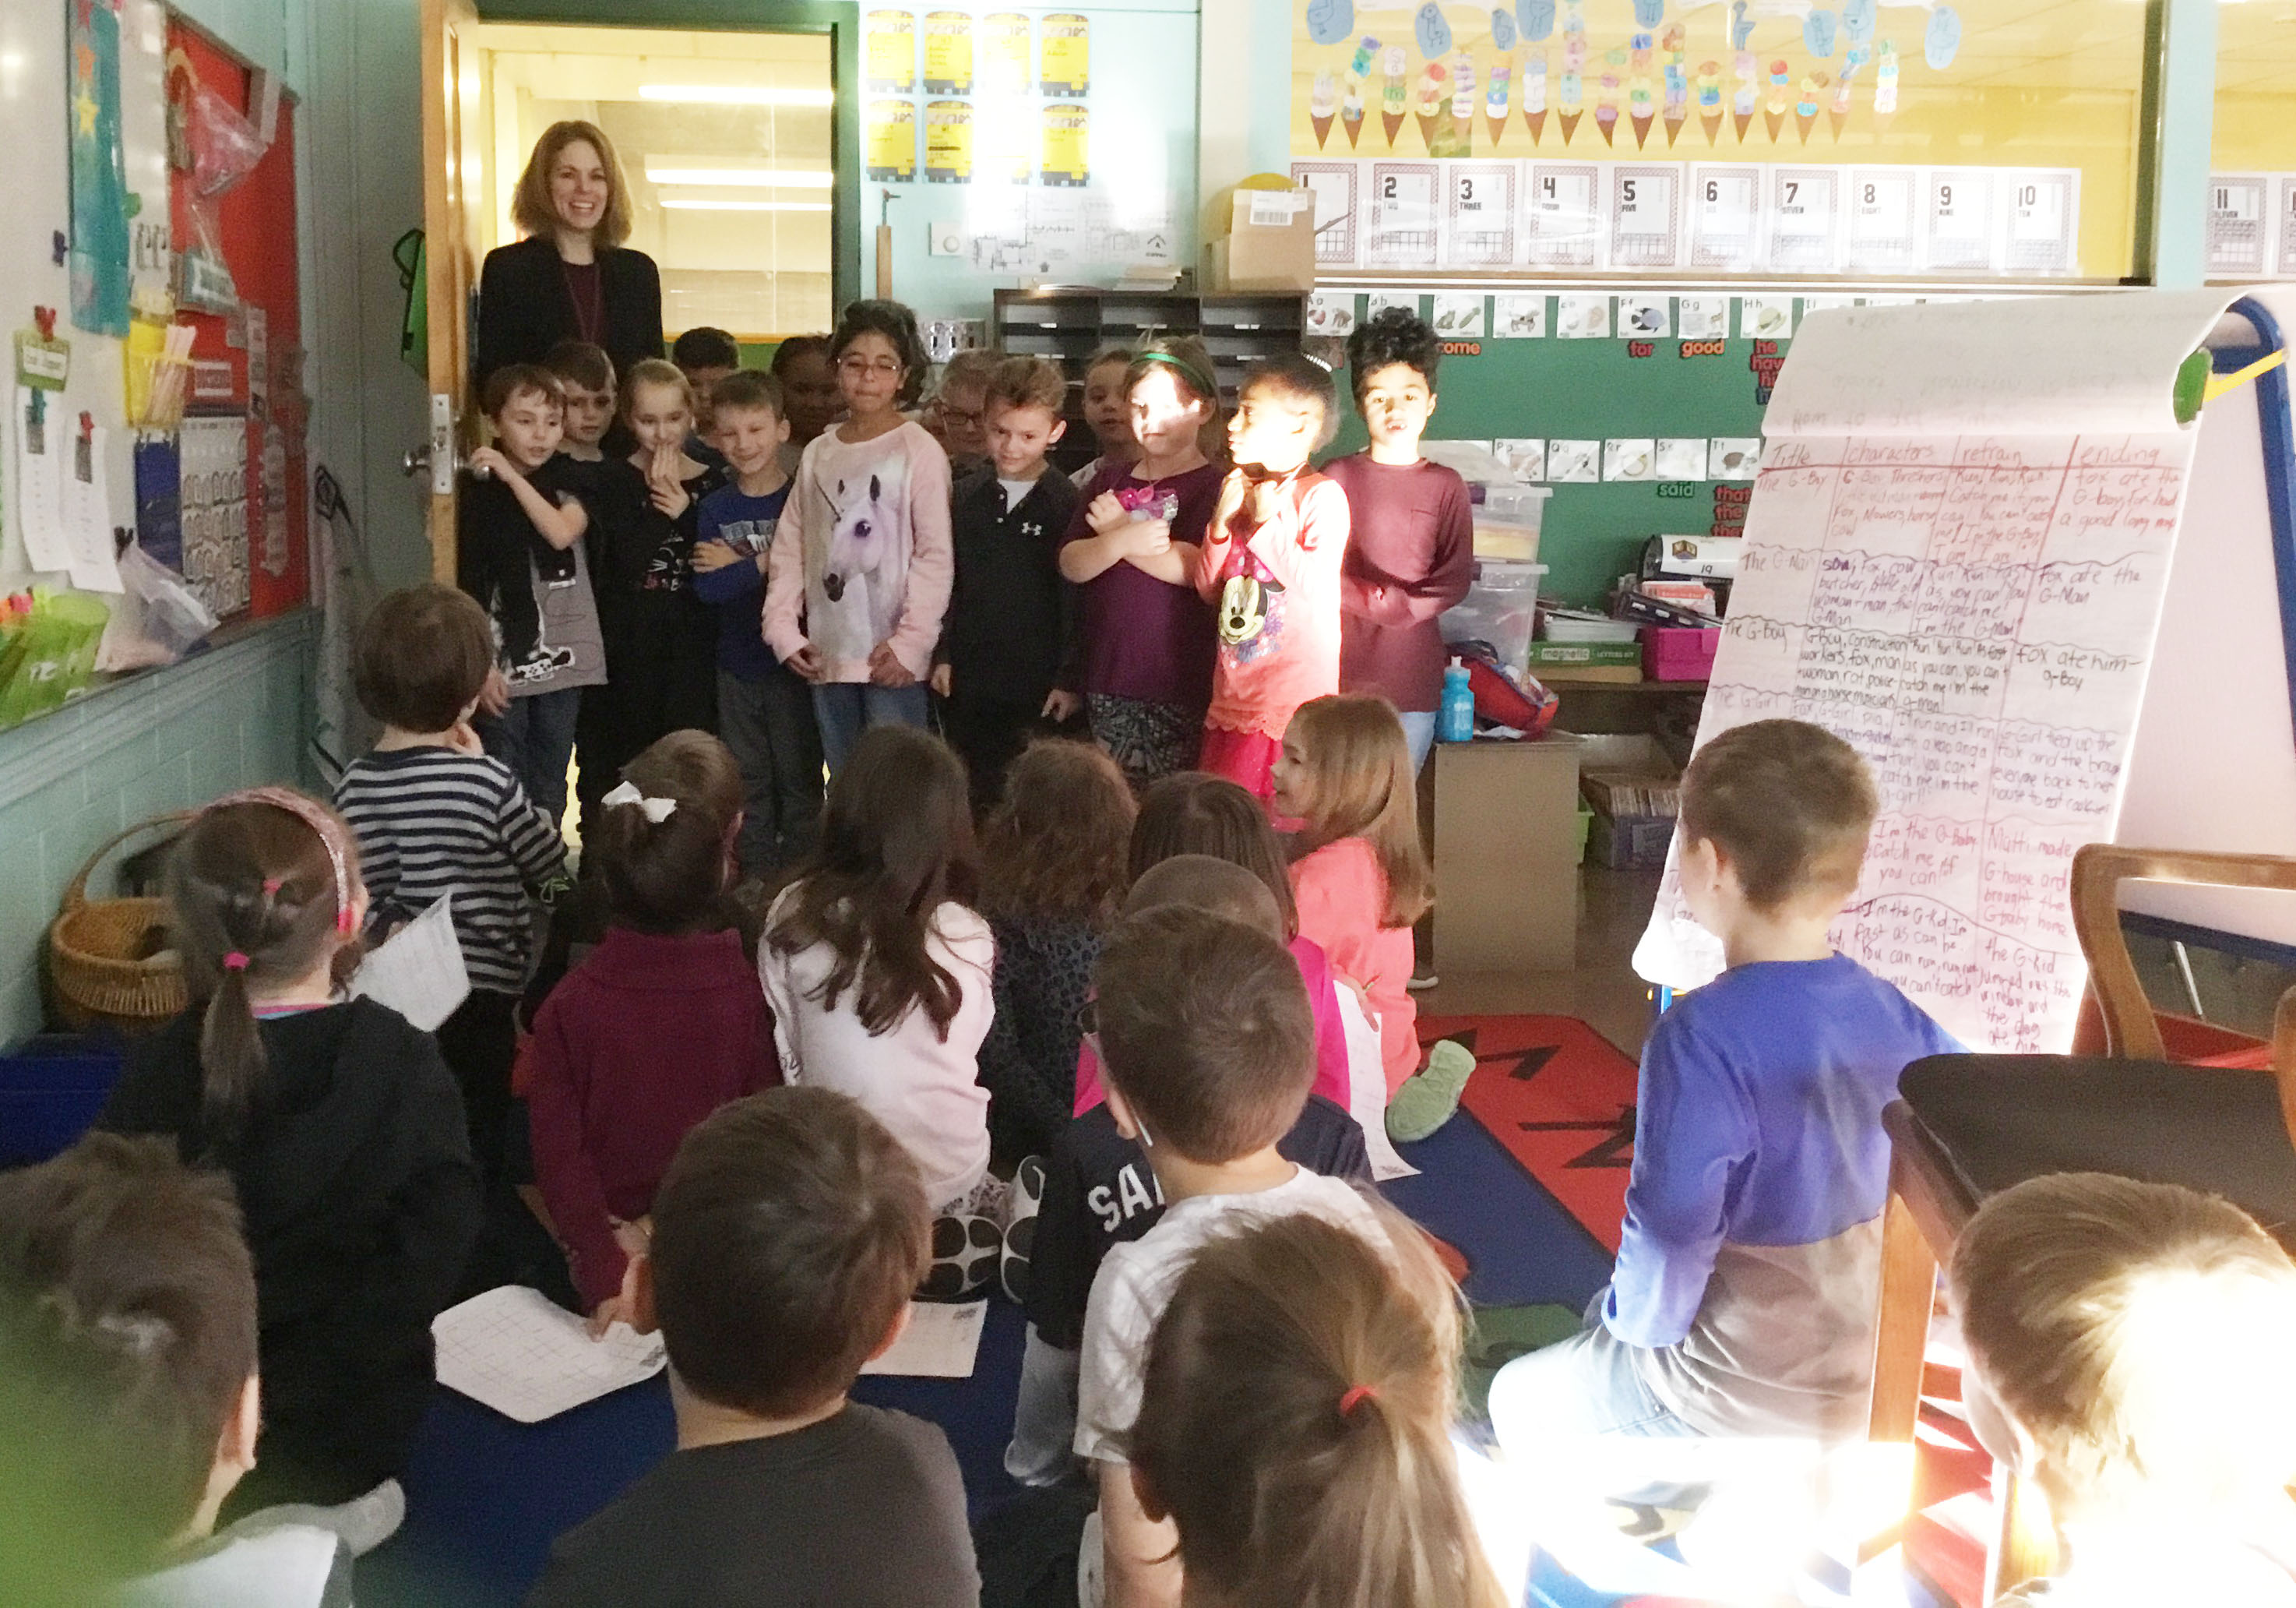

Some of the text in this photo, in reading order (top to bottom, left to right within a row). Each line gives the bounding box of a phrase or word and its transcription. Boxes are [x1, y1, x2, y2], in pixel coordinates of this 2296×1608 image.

[1384, 177, 1397, 198] 2
[1460, 179, 1473, 200] 3
[1544, 178, 1556, 199] 4
[1623, 180, 1636, 202] 5
[1706, 181, 1718, 203] 6
[1785, 182, 1799, 203] 7
[1864, 184, 1875, 204] 8
[1940, 186, 1952, 206] 9
[2018, 186, 2037, 207] 10
[2217, 189, 2228, 209] 11
[1630, 340, 1654, 357] for
[1682, 340, 1724, 358] good
[1755, 340, 1777, 354] he
[1773, 443, 1811, 466] Title
[1963, 438, 2022, 467] refrain
[2080, 436, 2161, 468] ending
[1659, 482, 1694, 496] said
[1715, 505, 1744, 520] the
[2079, 509, 2119, 536] good
[1741, 552, 1765, 572] The
[2069, 562, 2101, 584] ate
[2114, 561, 2142, 586] the
[2039, 586, 2090, 605] G-Man
[1543, 649, 1589, 661] magnetic
[1875, 655, 1901, 668] man
[2057, 649, 2089, 668] ate
[1964, 664, 1981, 682] you
[1970, 681, 1989, 696] the
[1934, 719, 1957, 735] and
[2076, 735, 2093, 752] up
[2097, 729, 2117, 752] the
[2030, 751, 2059, 767] and
[2061, 750, 2083, 767] the
[1953, 777, 1979, 795] the
[2028, 794, 2042, 806] to
[1907, 821, 1928, 840] the
[1873, 841, 1910, 859] Catch
[1915, 853, 1934, 865] me
[2038, 837, 2072, 857] made
[1879, 868, 1937, 887] you can
[2041, 870, 2066, 891] and
[1889, 902, 1909, 917] the
[2038, 895, 2064, 909] the
[1855, 923, 1937, 945] fast as can
[1889, 950, 1912, 964] can
[1984, 936, 2007, 961] the
[1940, 978, 1972, 996] catch
[2053, 979, 2071, 998] the
[2028, 998, 2048, 1014] and
[1984, 1010, 2041, 1037] the dog
[1987, 1028, 2041, 1053] ate him
